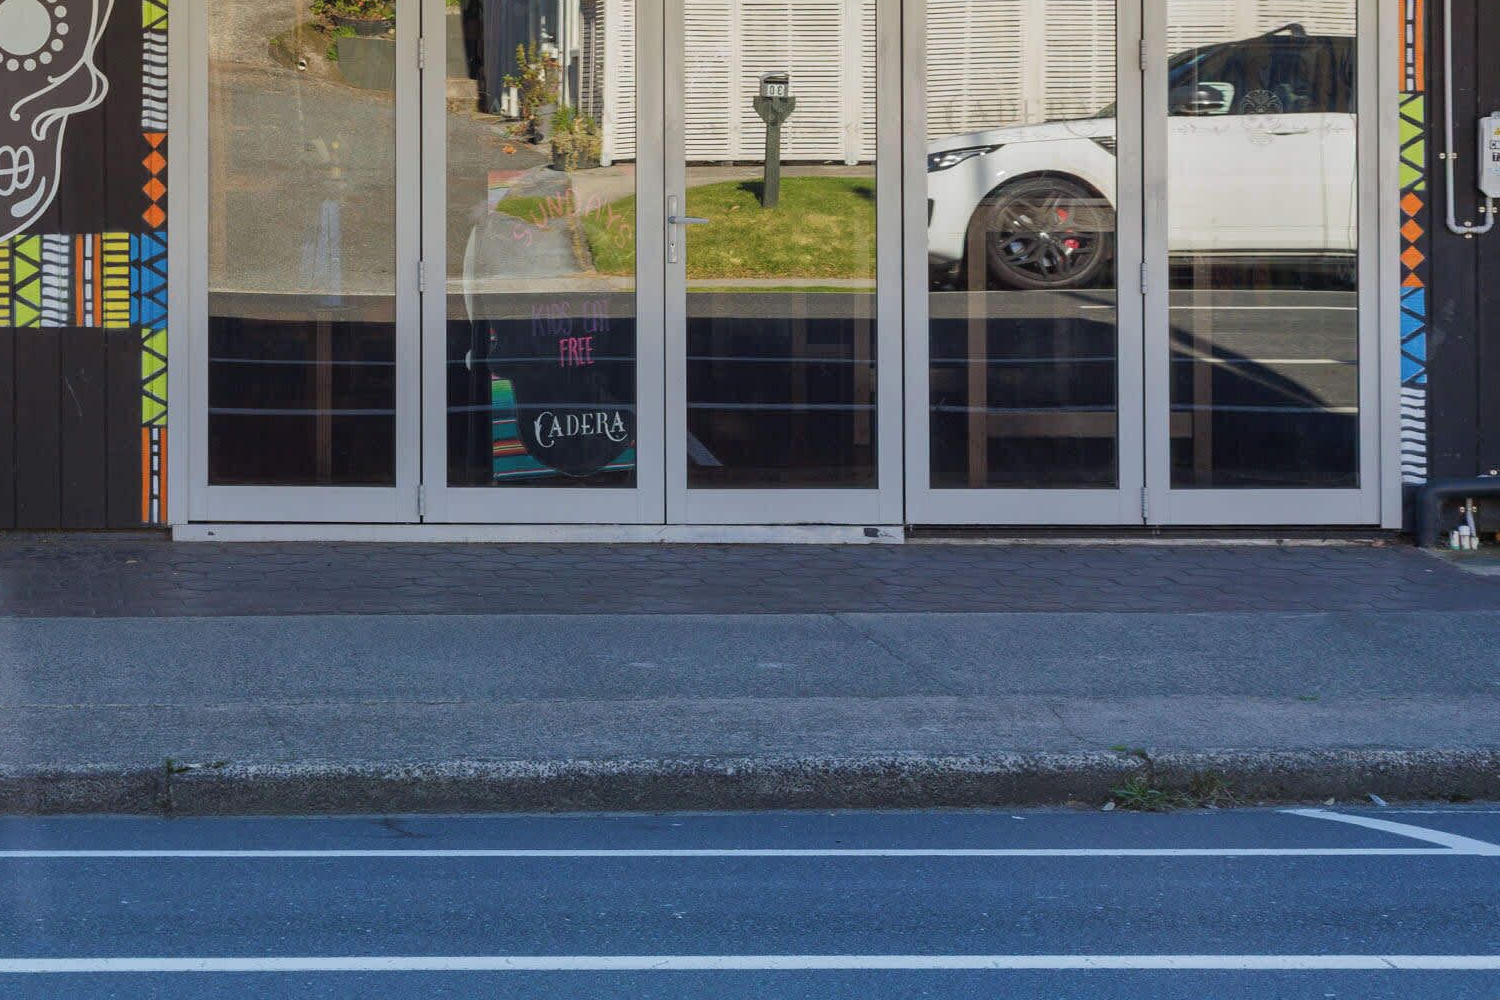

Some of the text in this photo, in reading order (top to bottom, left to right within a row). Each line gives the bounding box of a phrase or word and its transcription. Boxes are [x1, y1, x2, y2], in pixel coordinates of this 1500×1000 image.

[511, 188, 633, 249] SUNDAYS
[558, 336, 596, 368] FREE
[533, 410, 629, 449] CADERA
